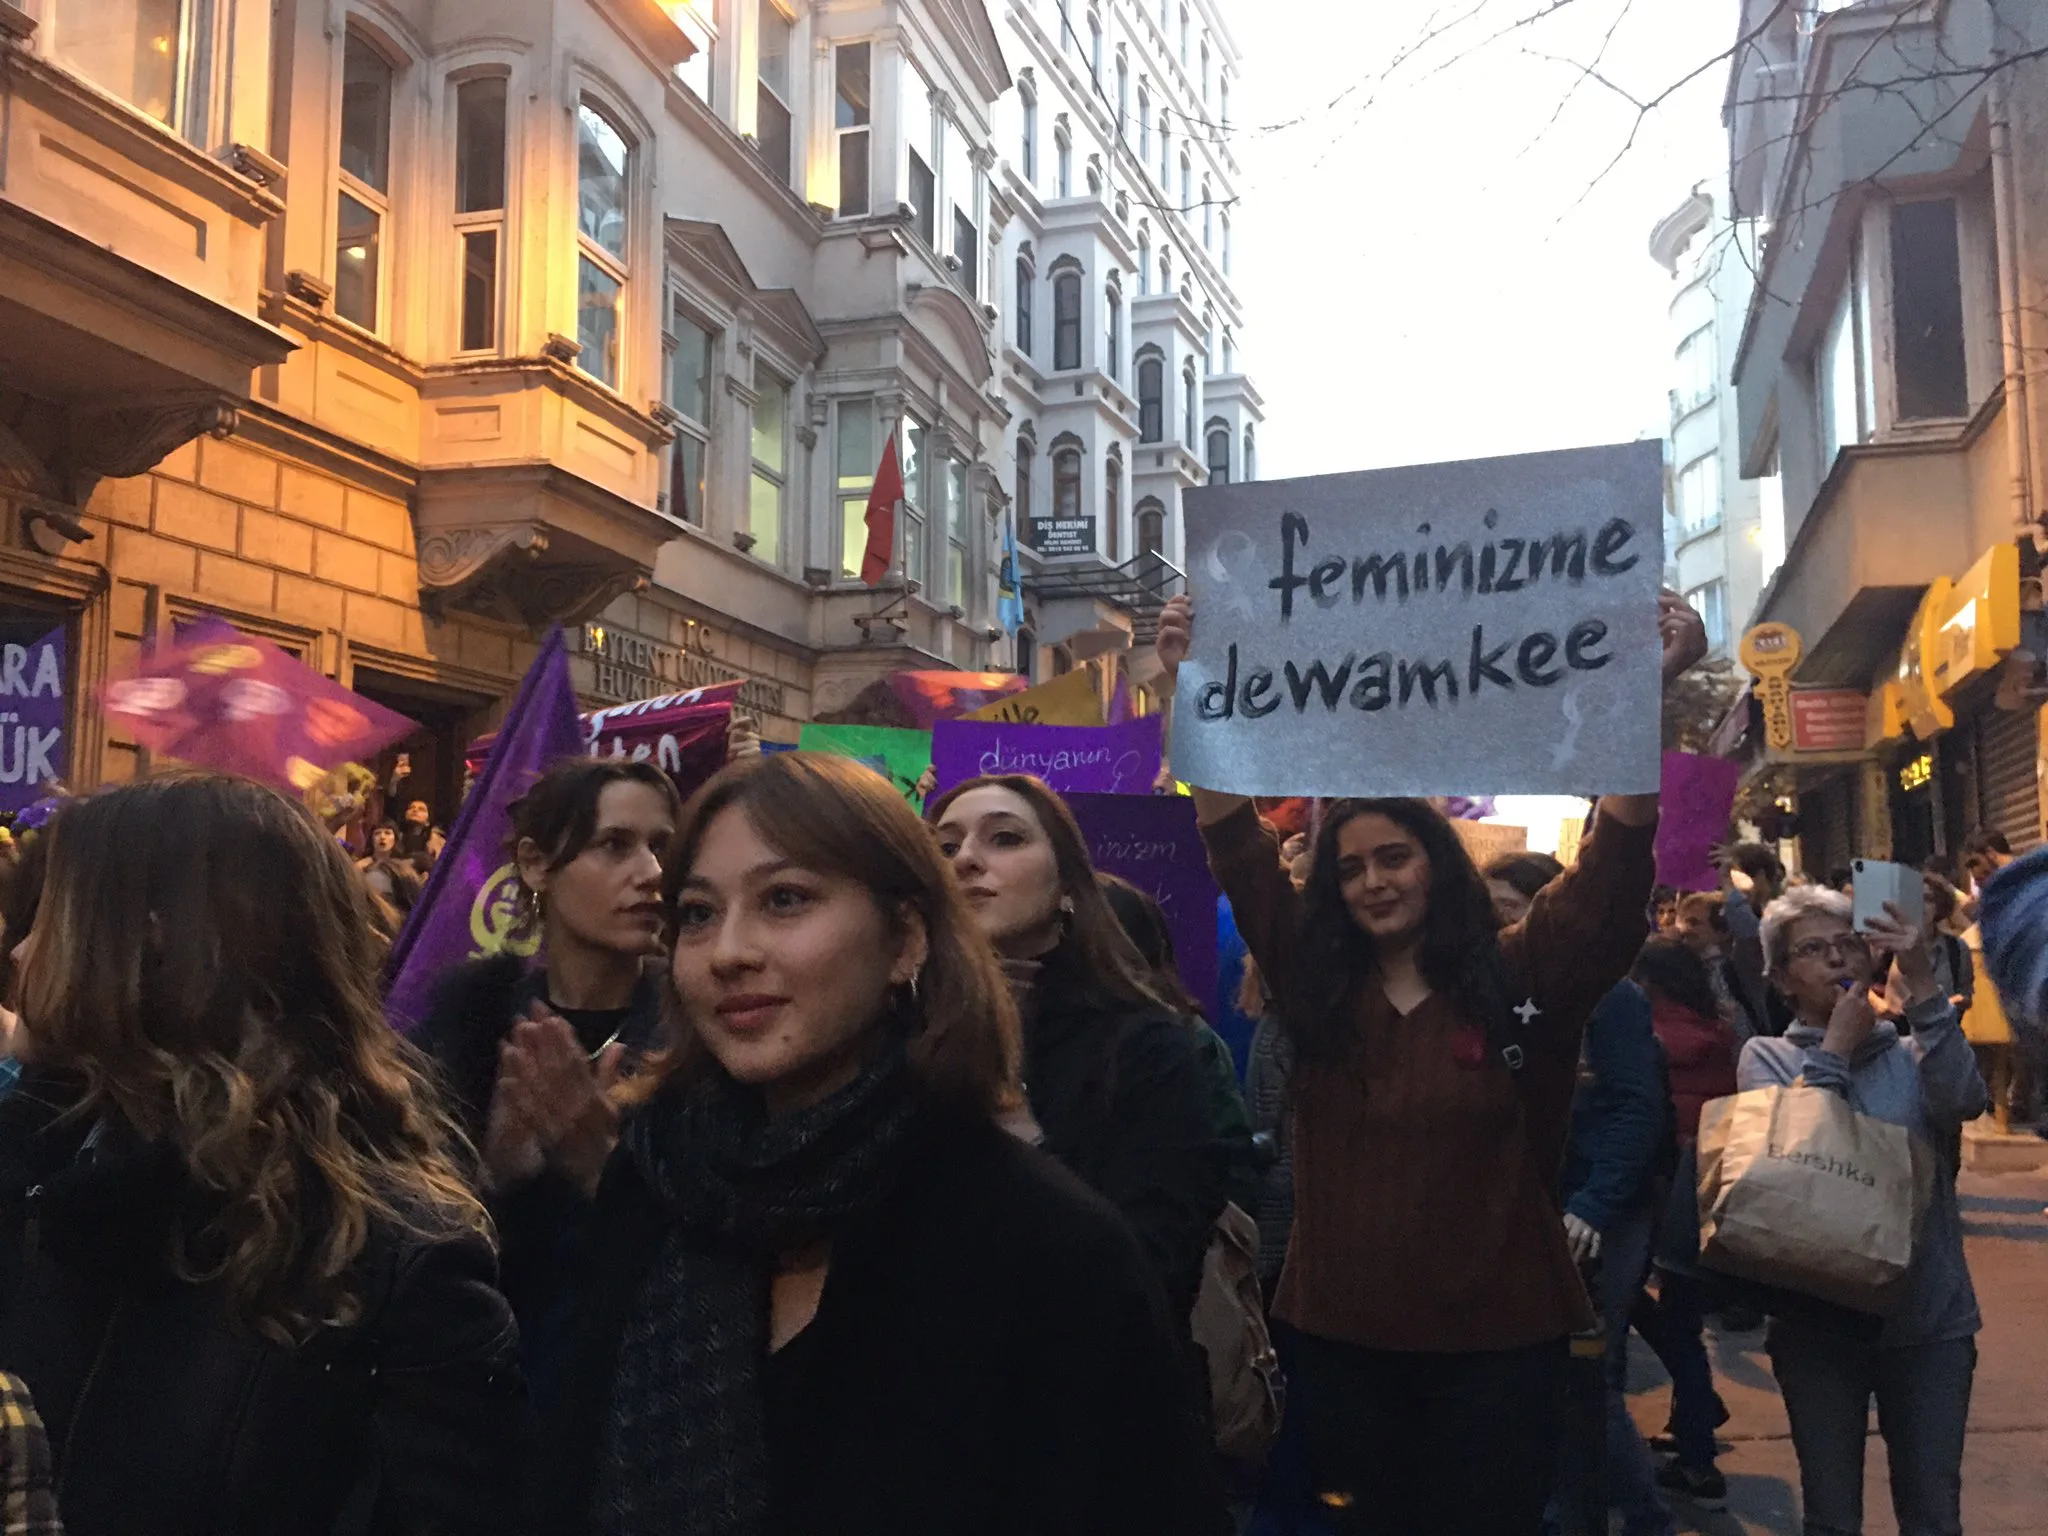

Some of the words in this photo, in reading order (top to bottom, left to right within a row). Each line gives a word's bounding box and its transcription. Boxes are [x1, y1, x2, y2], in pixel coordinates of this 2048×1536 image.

[1269, 508, 1640, 622] feminizme
[0, 643, 62, 697] RA
[1195, 619, 1616, 721] dewamkee
[1767, 1143, 1876, 1188] Bershka
